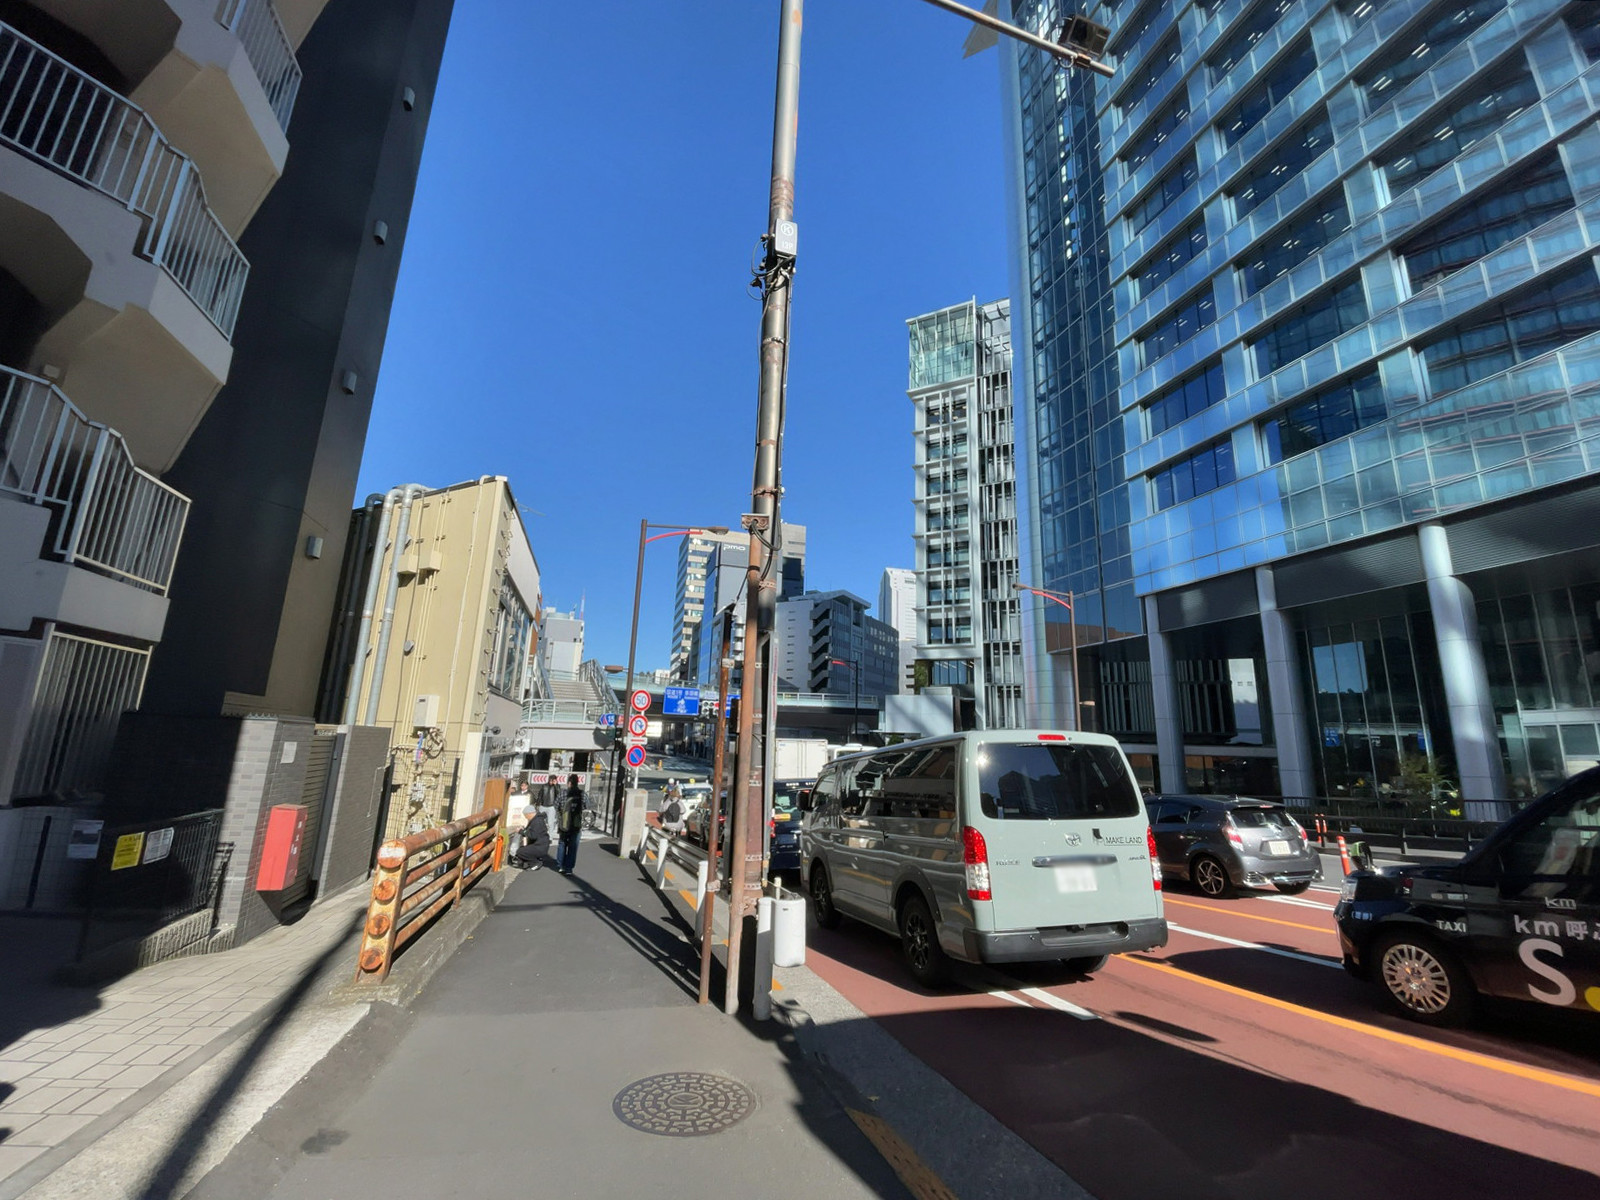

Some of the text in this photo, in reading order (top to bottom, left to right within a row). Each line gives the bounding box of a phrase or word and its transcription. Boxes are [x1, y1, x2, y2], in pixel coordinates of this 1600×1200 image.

[635, 696, 646, 705] 50
[607, 715, 615, 723] 15
[1105, 836, 1143, 844] MAKE LAND
[1545, 896, 1577, 909] km
[1436, 919, 1467, 933] TAXI
